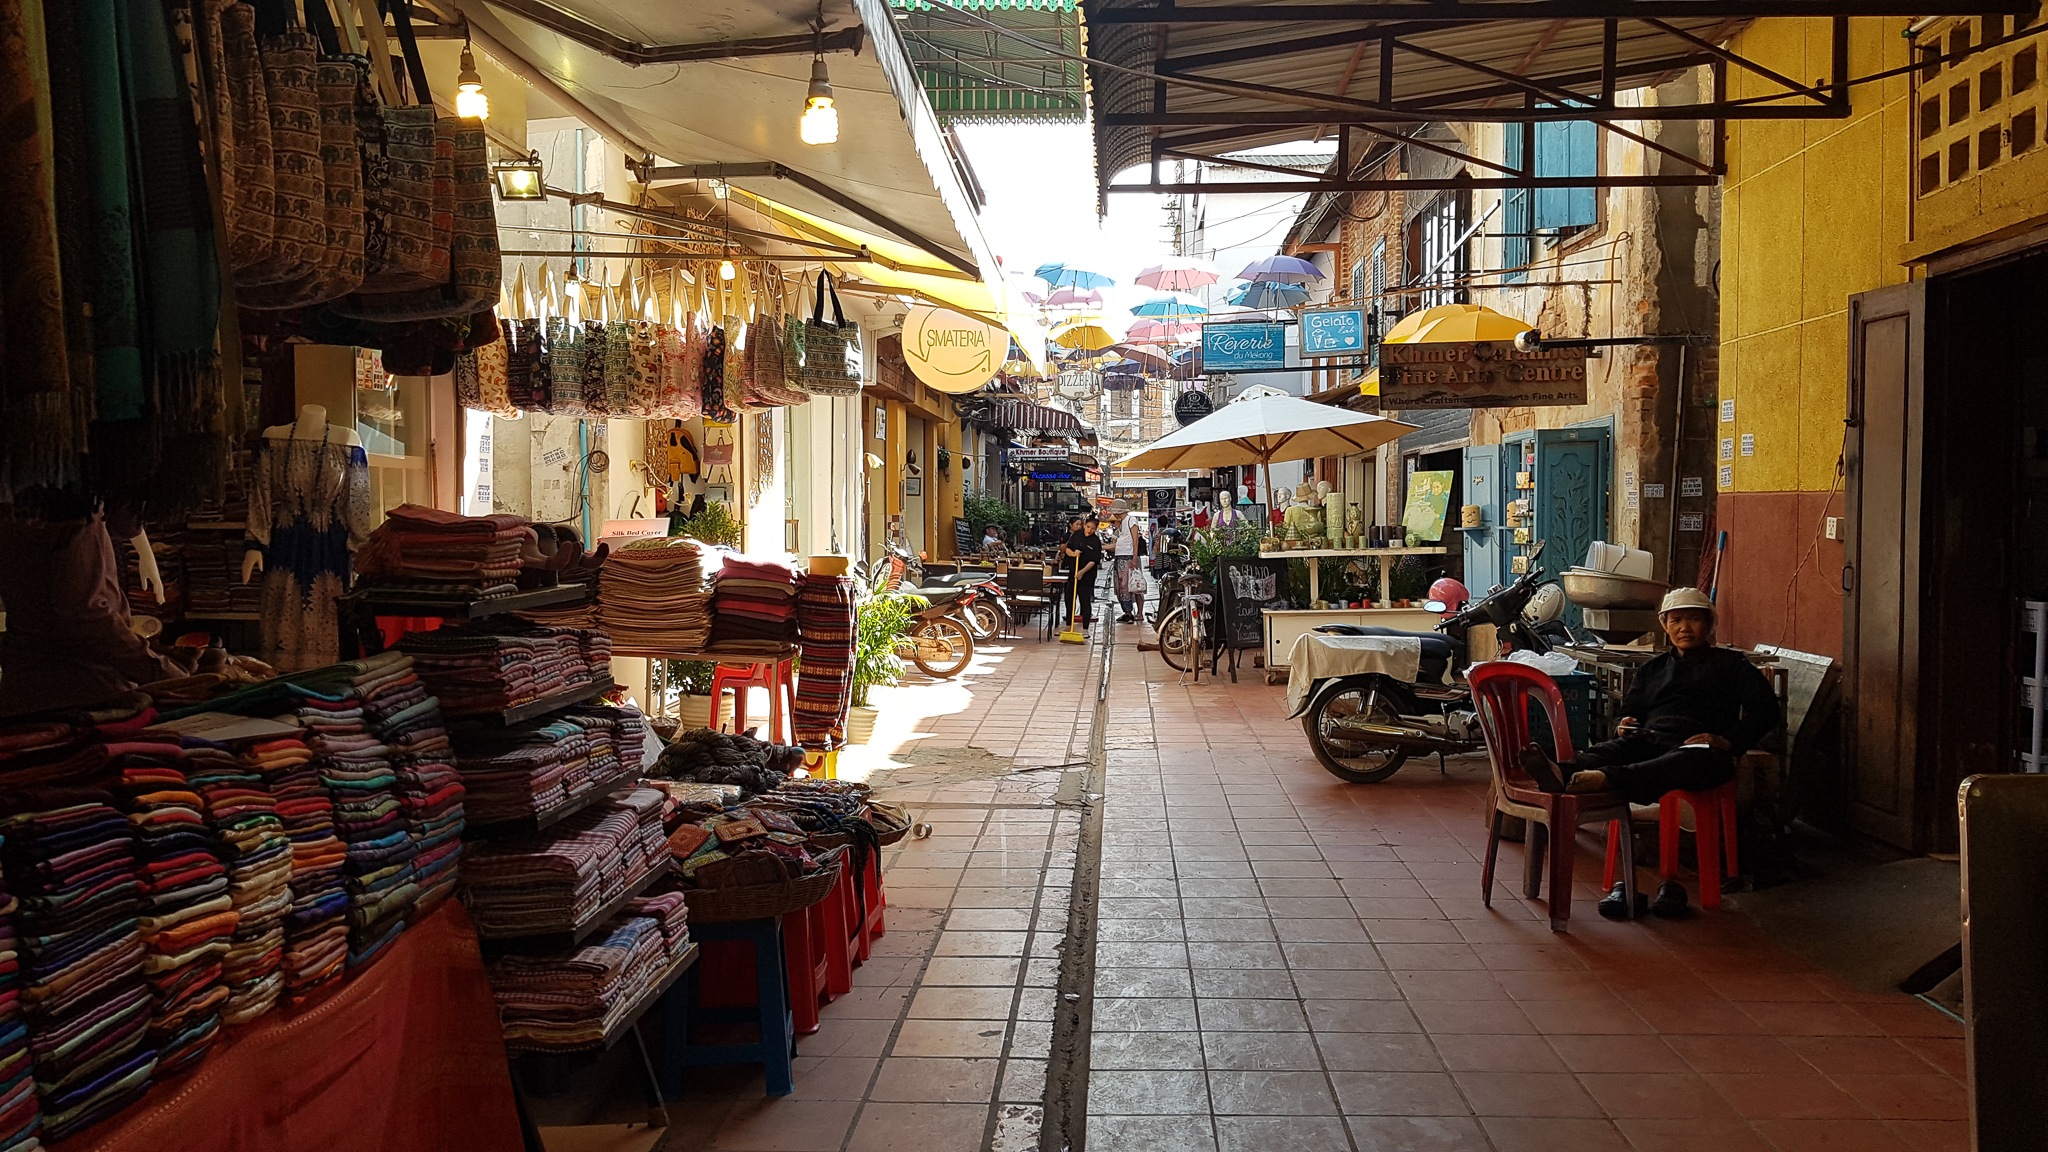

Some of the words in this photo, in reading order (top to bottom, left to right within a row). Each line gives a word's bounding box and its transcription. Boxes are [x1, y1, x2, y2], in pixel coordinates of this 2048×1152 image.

[1311, 314, 1355, 328] Gelato
[1337, 325, 1355, 335] lab
[926, 329, 985, 348] SMATERIA
[1210, 333, 1274, 355] Rêverie
[1233, 351, 1244, 360] du
[1244, 350, 1273, 361] Mekong
[1386, 345, 1470, 365] Khmer
[1386, 365, 1438, 386] Fine
[1504, 361, 1584, 383] Centre
[1532, 392, 1554, 400] Fine
[1556, 391, 1577, 400] Arts
[1015, 448, 1037, 456] Khmer
